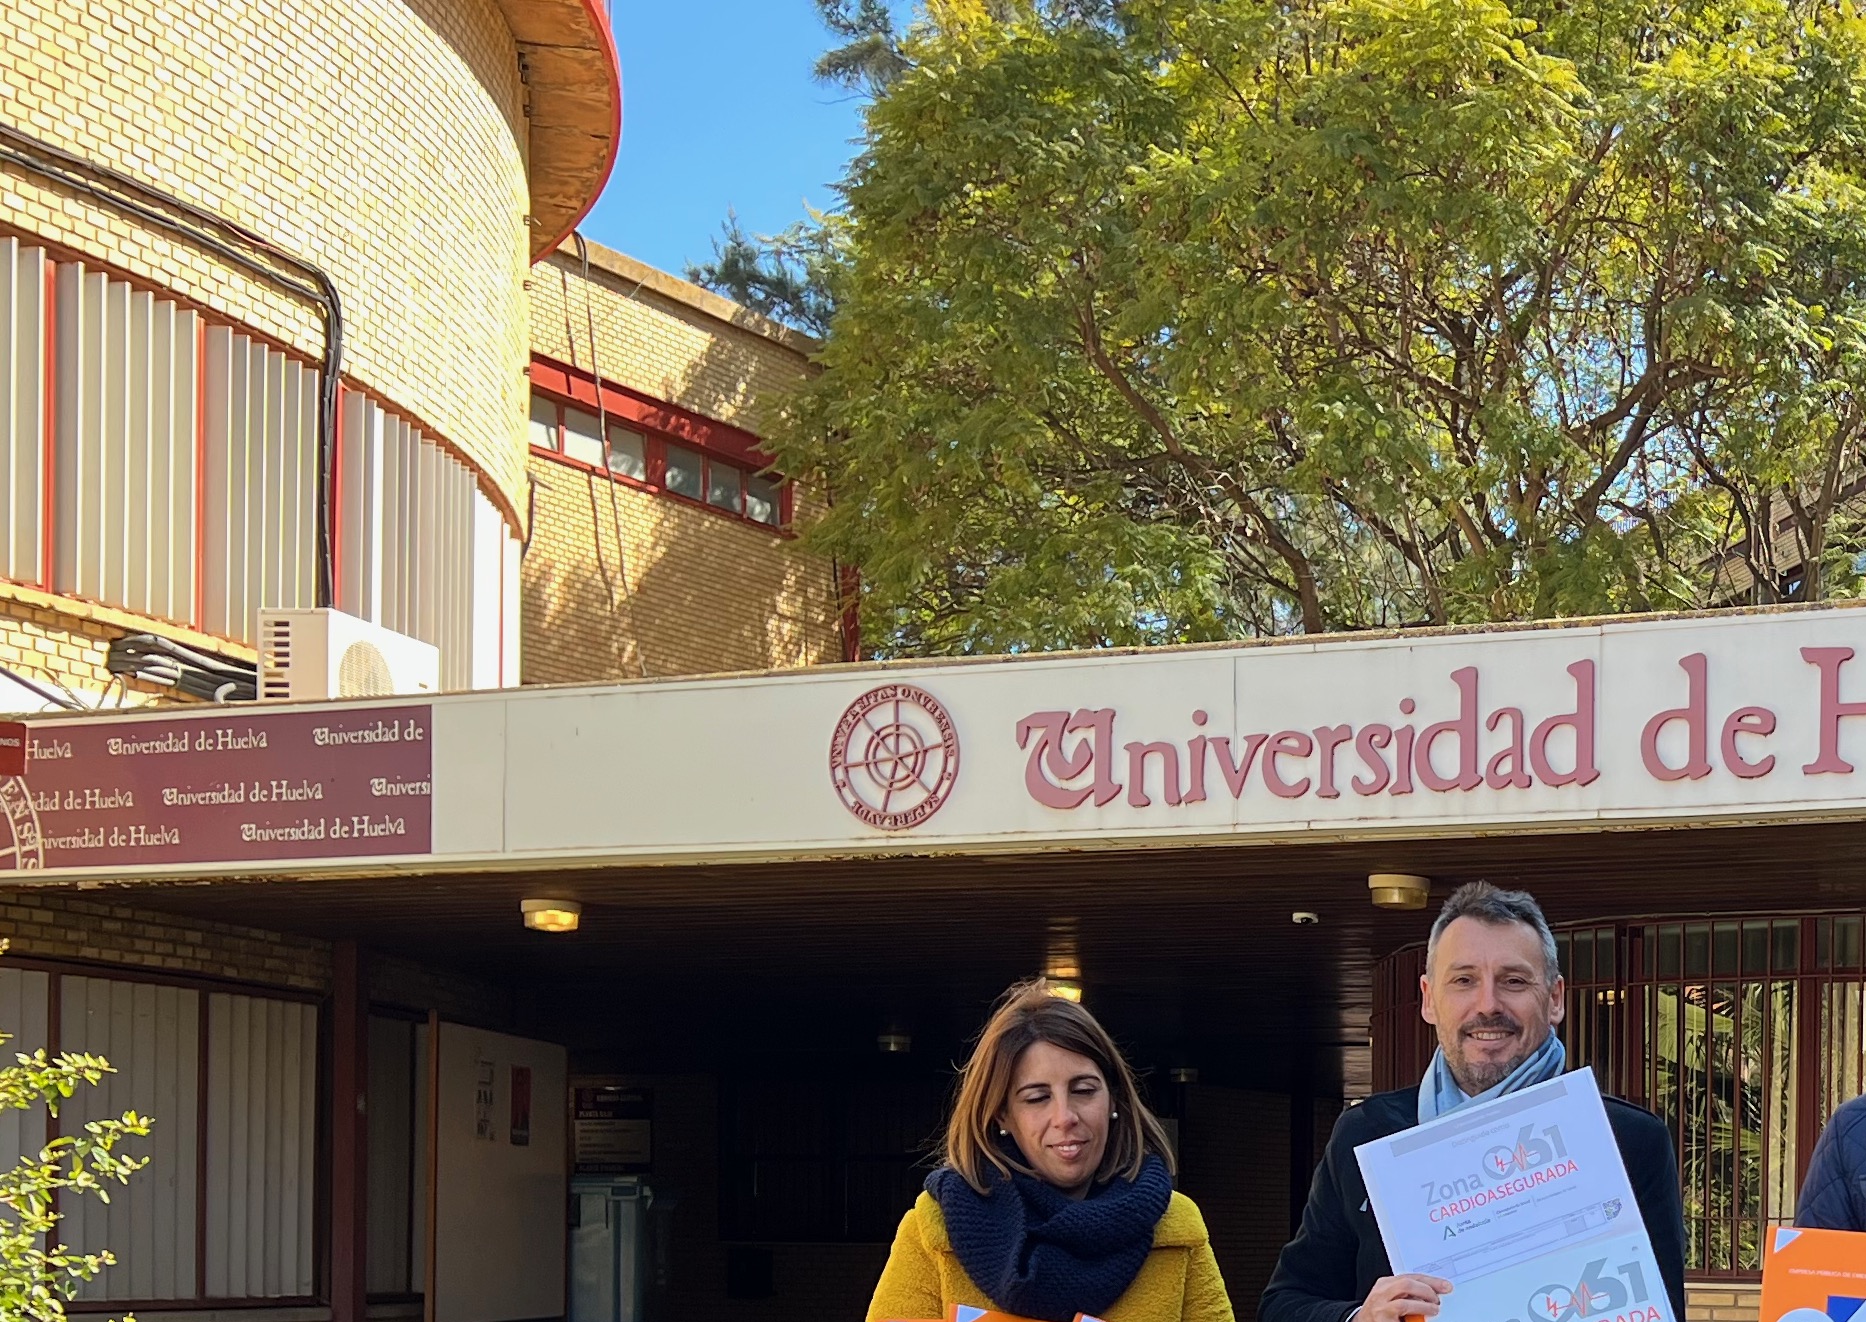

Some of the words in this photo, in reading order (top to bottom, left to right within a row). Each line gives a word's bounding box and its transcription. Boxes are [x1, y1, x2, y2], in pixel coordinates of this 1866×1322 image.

[106, 731, 189, 756] Universidad
[194, 731, 214, 751] de
[215, 727, 268, 751] Huelva
[312, 719, 400, 746] Universidad
[403, 719, 424, 741] de
[1015, 658, 1600, 810] Universidad
[1639, 651, 1777, 782] de
[26, 739, 73, 760] Huelva
[64, 790, 82, 810] de
[84, 787, 134, 810] Huelva
[161, 781, 245, 806] Universidad
[249, 781, 268, 802] de
[270, 779, 324, 802] Huelva
[369, 773, 431, 797] Universi
[109, 827, 127, 847] de
[129, 825, 180, 847] Huelva
[240, 817, 325, 842] Universidad
[329, 817, 350, 839] de
[352, 814, 406, 839] Huelva
[1420, 1173, 1484, 1207] Zona
[1482, 1122, 1568, 1180] 061
[1429, 1159, 1579, 1223] CARDIOASEGURADA
